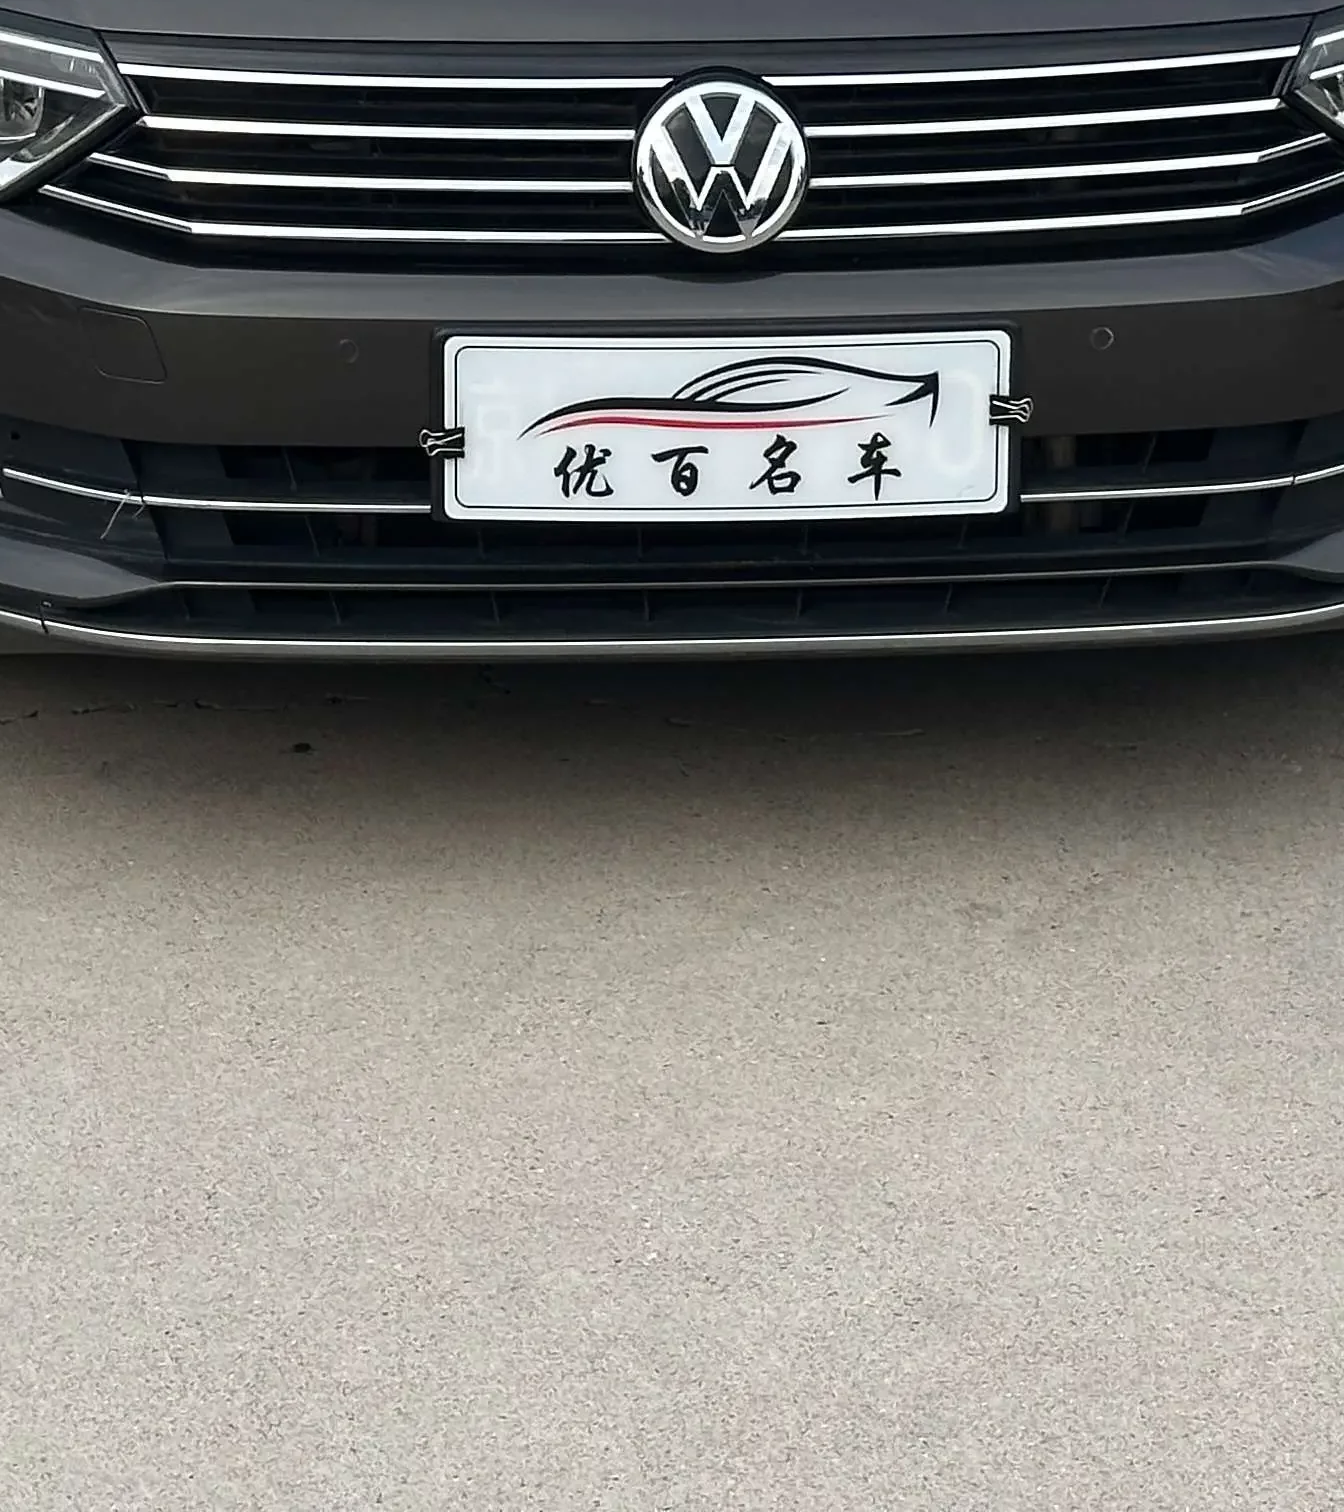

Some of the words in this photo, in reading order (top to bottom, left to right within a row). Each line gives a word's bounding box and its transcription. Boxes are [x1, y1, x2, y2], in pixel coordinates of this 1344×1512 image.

[643, 86, 799, 242] VW
[553, 431, 902, 501] 优百名车
